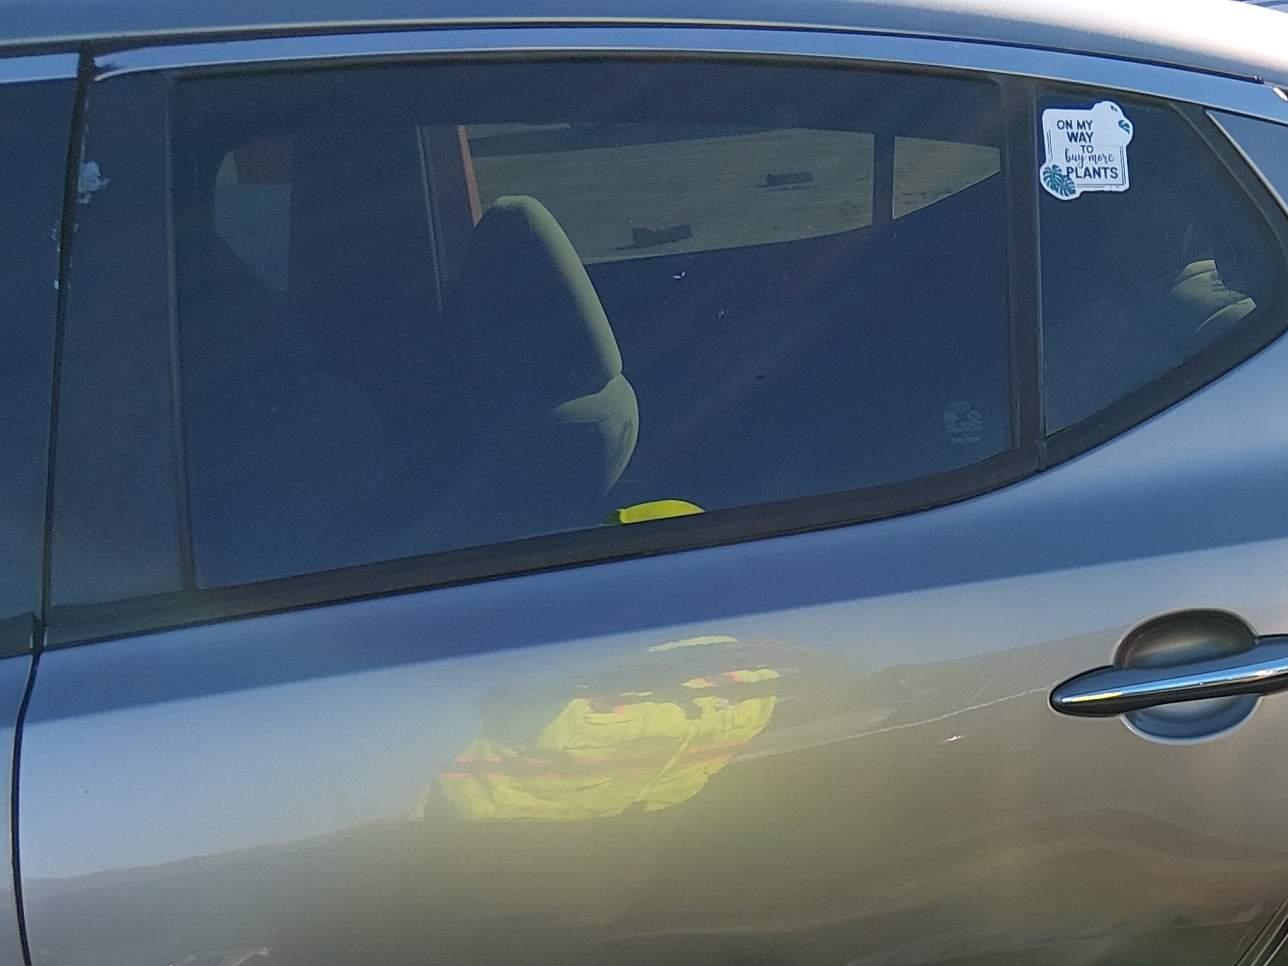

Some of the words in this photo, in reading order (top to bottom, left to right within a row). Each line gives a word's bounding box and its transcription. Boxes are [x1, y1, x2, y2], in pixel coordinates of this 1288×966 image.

[1057, 120, 1073, 130] ON
[1077, 120, 1093, 130] MY
[1067, 132, 1093, 143] WAY
[1081, 145, 1094, 154] TO
[1065, 148, 1084, 168] buy
[1088, 153, 1114, 164] more
[1065, 166, 1119, 179] PLANTS
